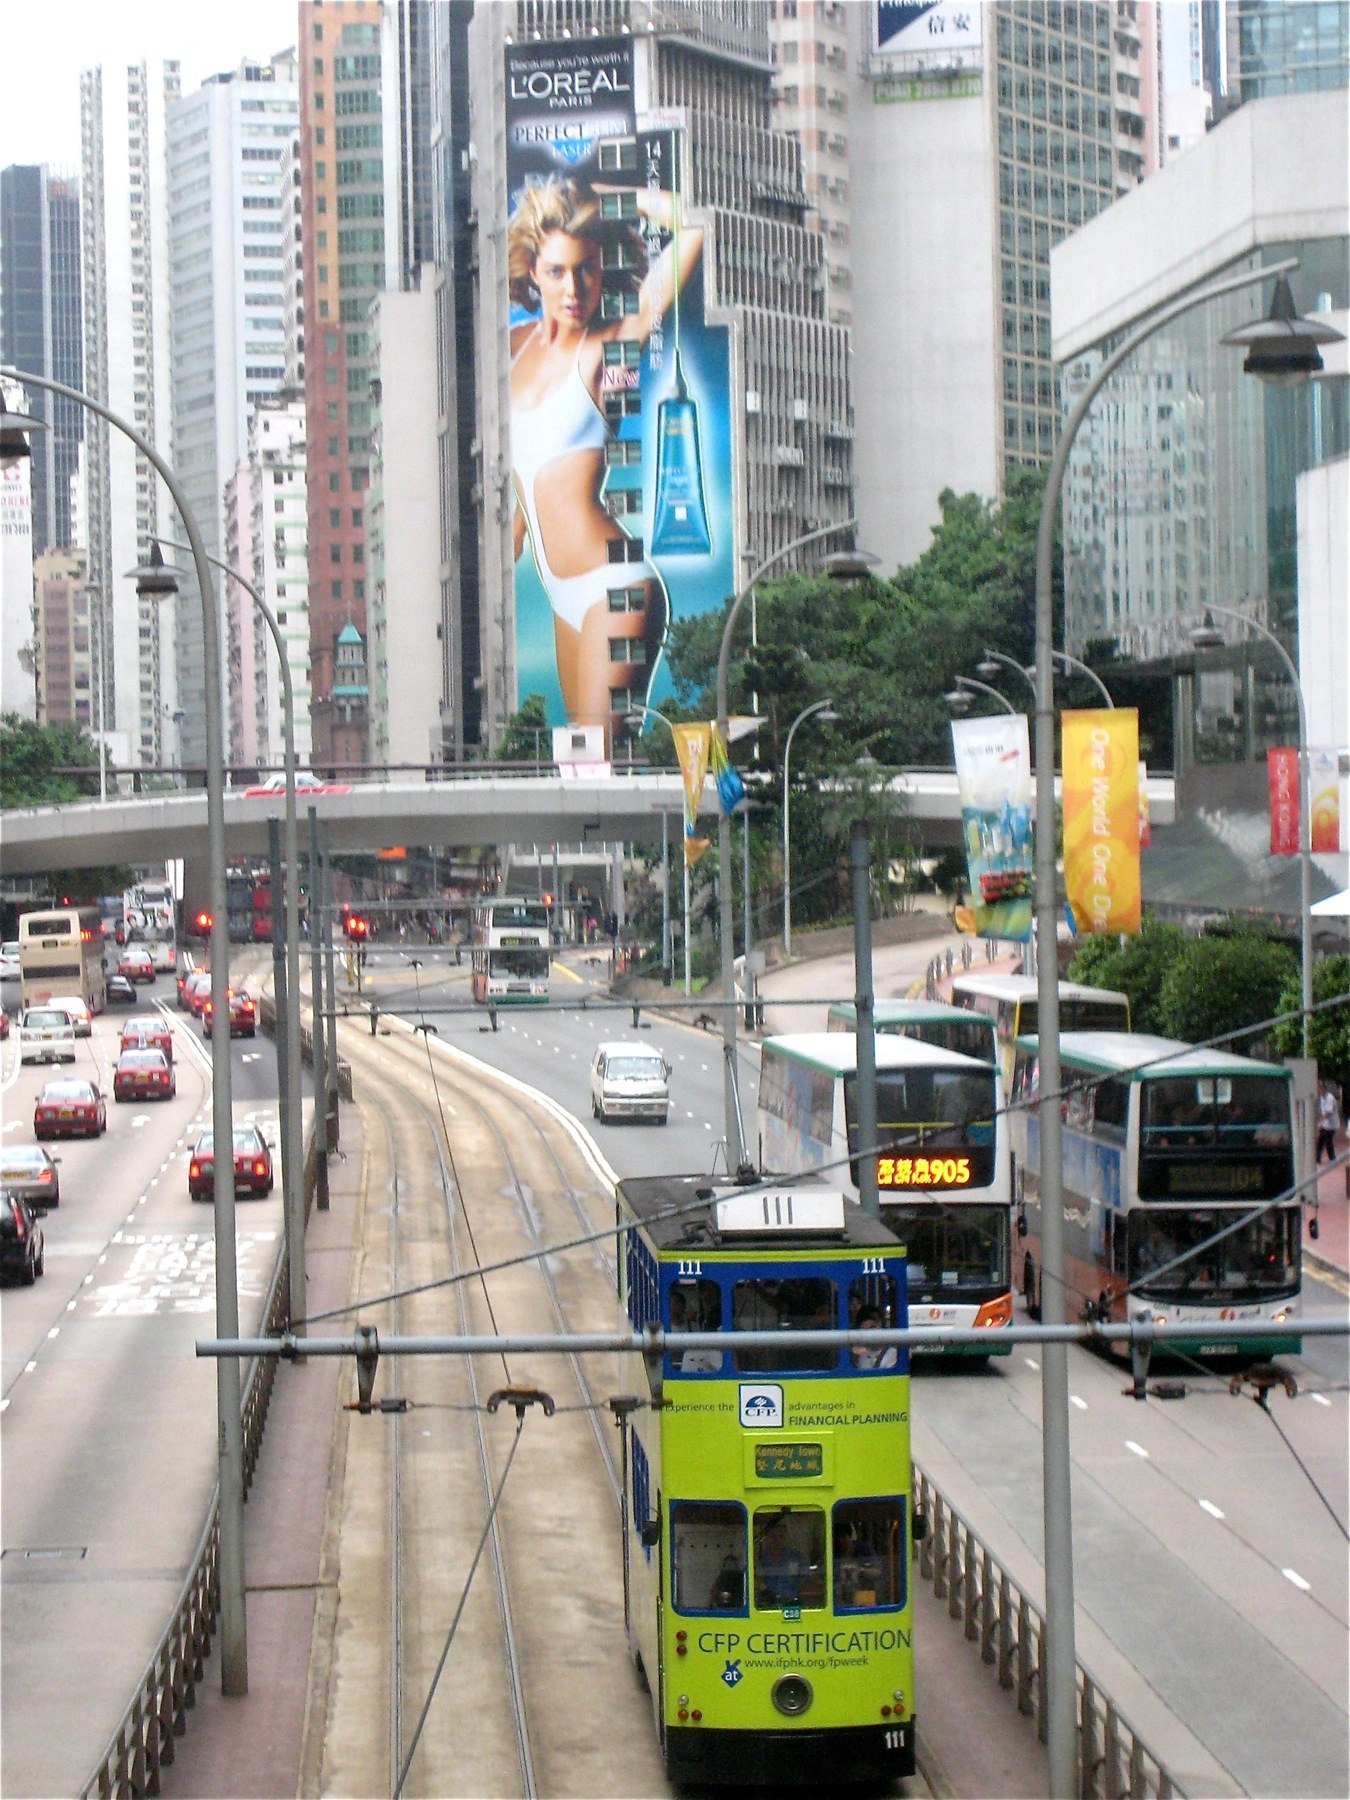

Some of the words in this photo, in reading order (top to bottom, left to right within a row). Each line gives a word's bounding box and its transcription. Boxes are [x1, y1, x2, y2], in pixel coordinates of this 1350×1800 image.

[557, 54, 590, 71] you're
[591, 51, 620, 64] worth
[510, 68, 631, 100] L'ORÉAL
[549, 94, 593, 109] PARIS
[515, 123, 585, 142] PERFECT
[552, 141, 592, 159] LASER
[603, 368, 639, 388] New
[1091, 727, 1110, 771] One
[1092, 776, 1112, 837] World
[1093, 843, 1112, 886] One
[930, 1158, 971, 1184] 905
[762, 1195, 795, 1226] 111
[678, 1259, 703, 1276] 111
[863, 1257, 886, 1275] 111
[718, 1402, 735, 1412] the
[788, 1401, 844, 1413] advantages
[846, 1401, 856, 1411] in
[789, 1415, 850, 1426] FINANCIAL
[852, 1412, 908, 1424] PLANNING
[698, 1632, 740, 1653] CFP
[747, 1628, 911, 1654] CERTIFICATION
[745, 1655, 869, 1670] www.ifphk.org/fpweek
[725, 1669, 738, 1681] at
[885, 1729, 905, 1749] 111
